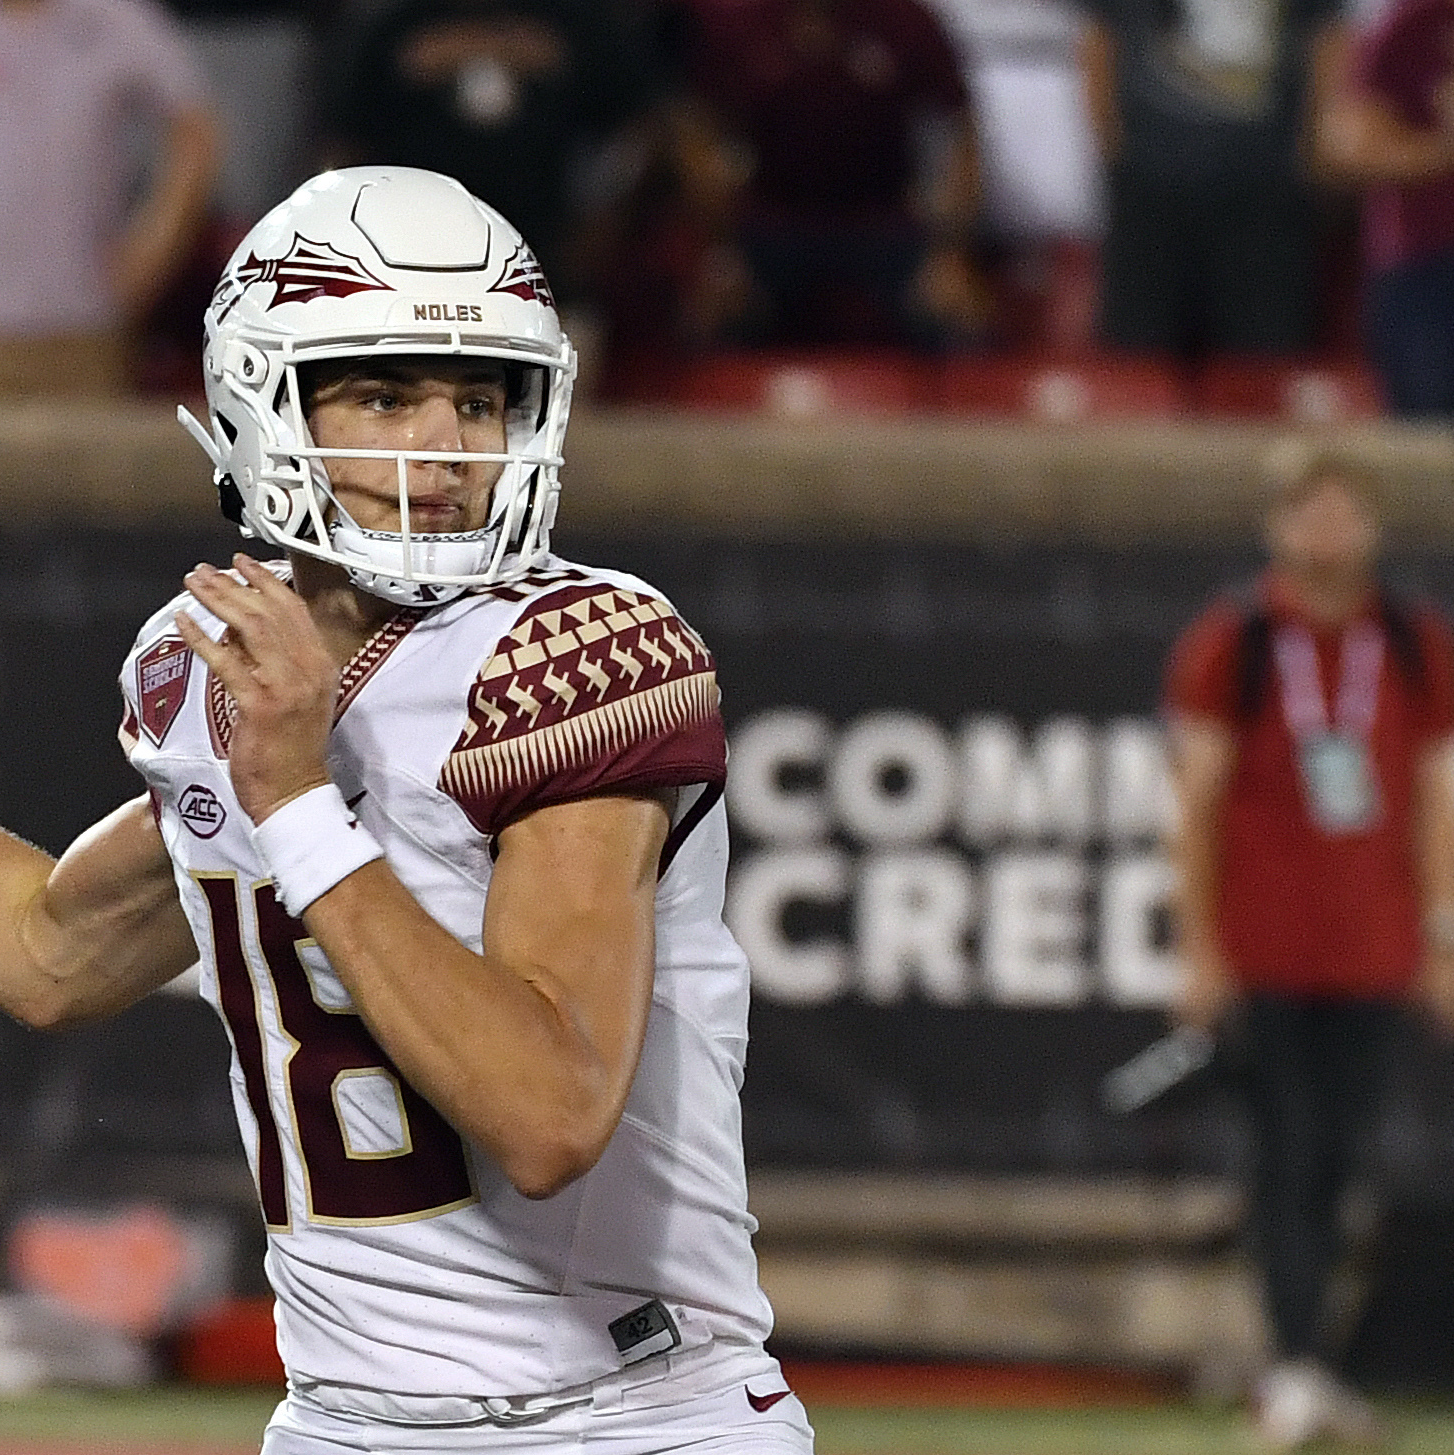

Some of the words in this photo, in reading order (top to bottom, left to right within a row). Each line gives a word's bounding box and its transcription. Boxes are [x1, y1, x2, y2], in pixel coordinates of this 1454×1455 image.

[412, 303, 483, 322] NOLES
[185, 796, 218, 818] ACC
[729, 846, 1187, 1006] CRED
